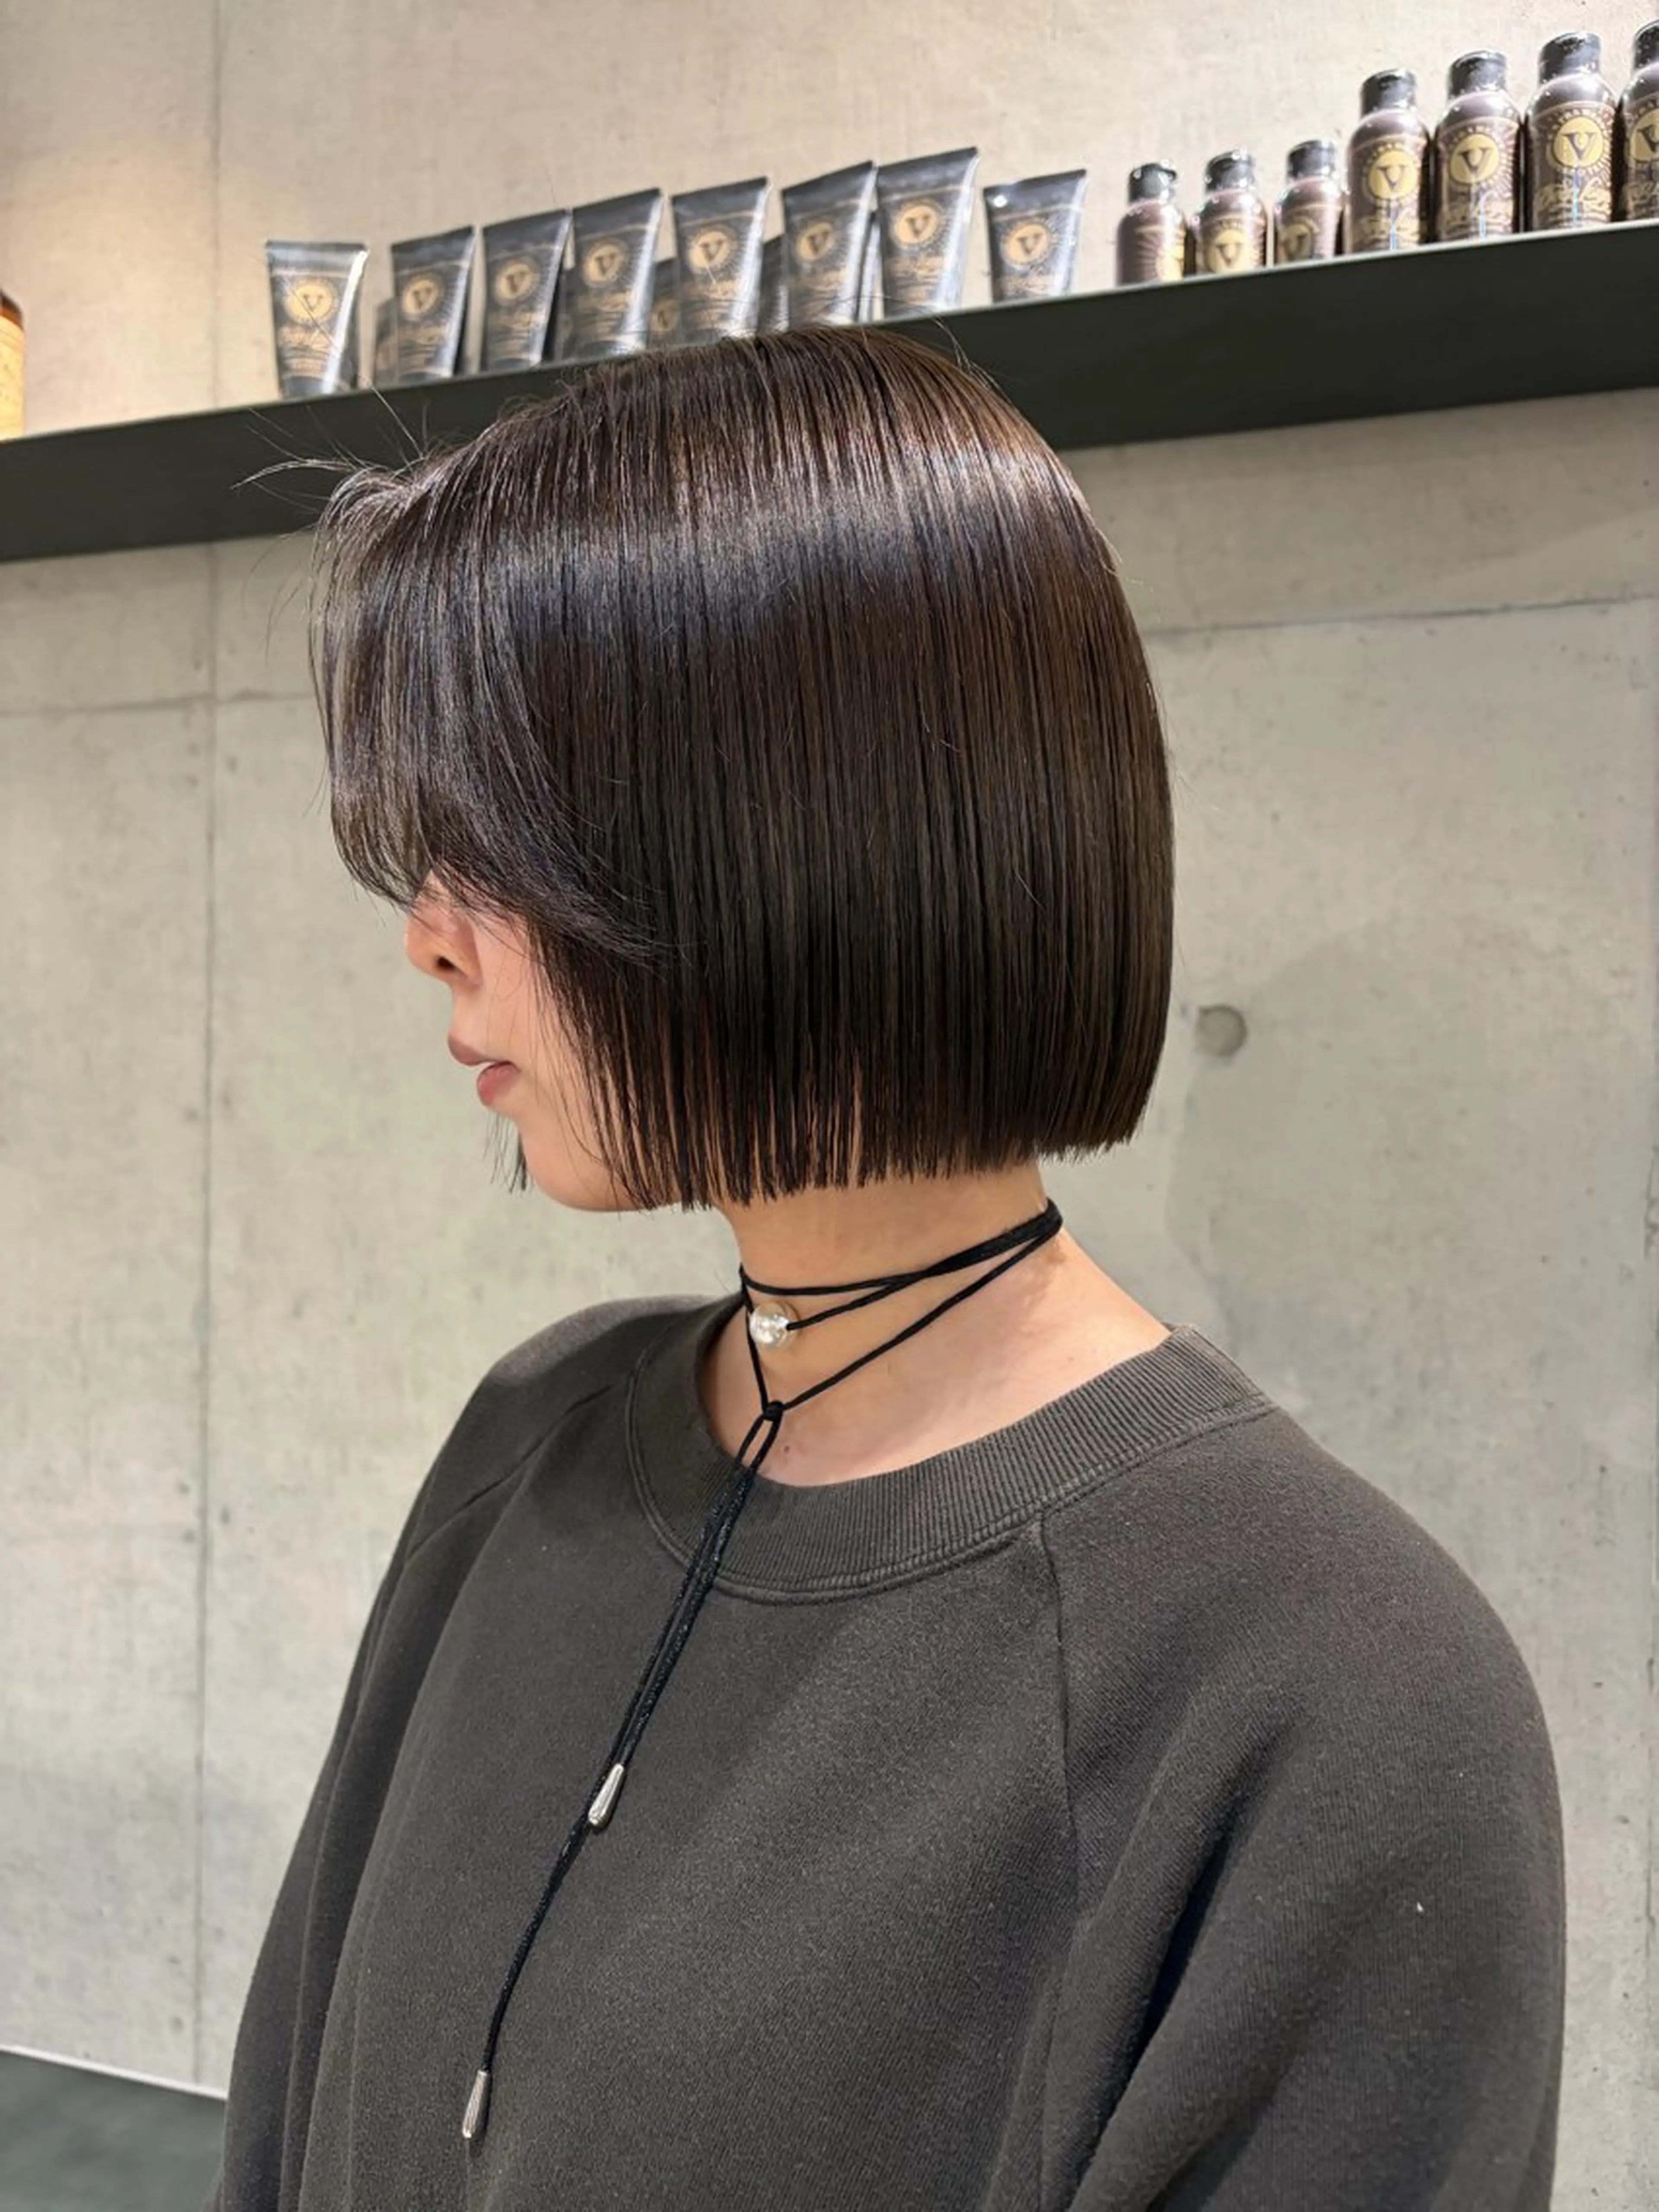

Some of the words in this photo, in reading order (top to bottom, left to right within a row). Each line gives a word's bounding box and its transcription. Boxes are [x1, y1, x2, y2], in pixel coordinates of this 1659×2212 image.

[1560, 131, 1597, 159] V
[1456, 147, 1493, 173] V
[1377, 163, 1408, 189] V
[906, 214, 931, 237] V
[699, 239, 724, 260] V
[808, 232, 830, 254] V
[1017, 233, 1042, 254] V
[596, 253, 617, 275] V
[1215, 243, 1243, 267] V
